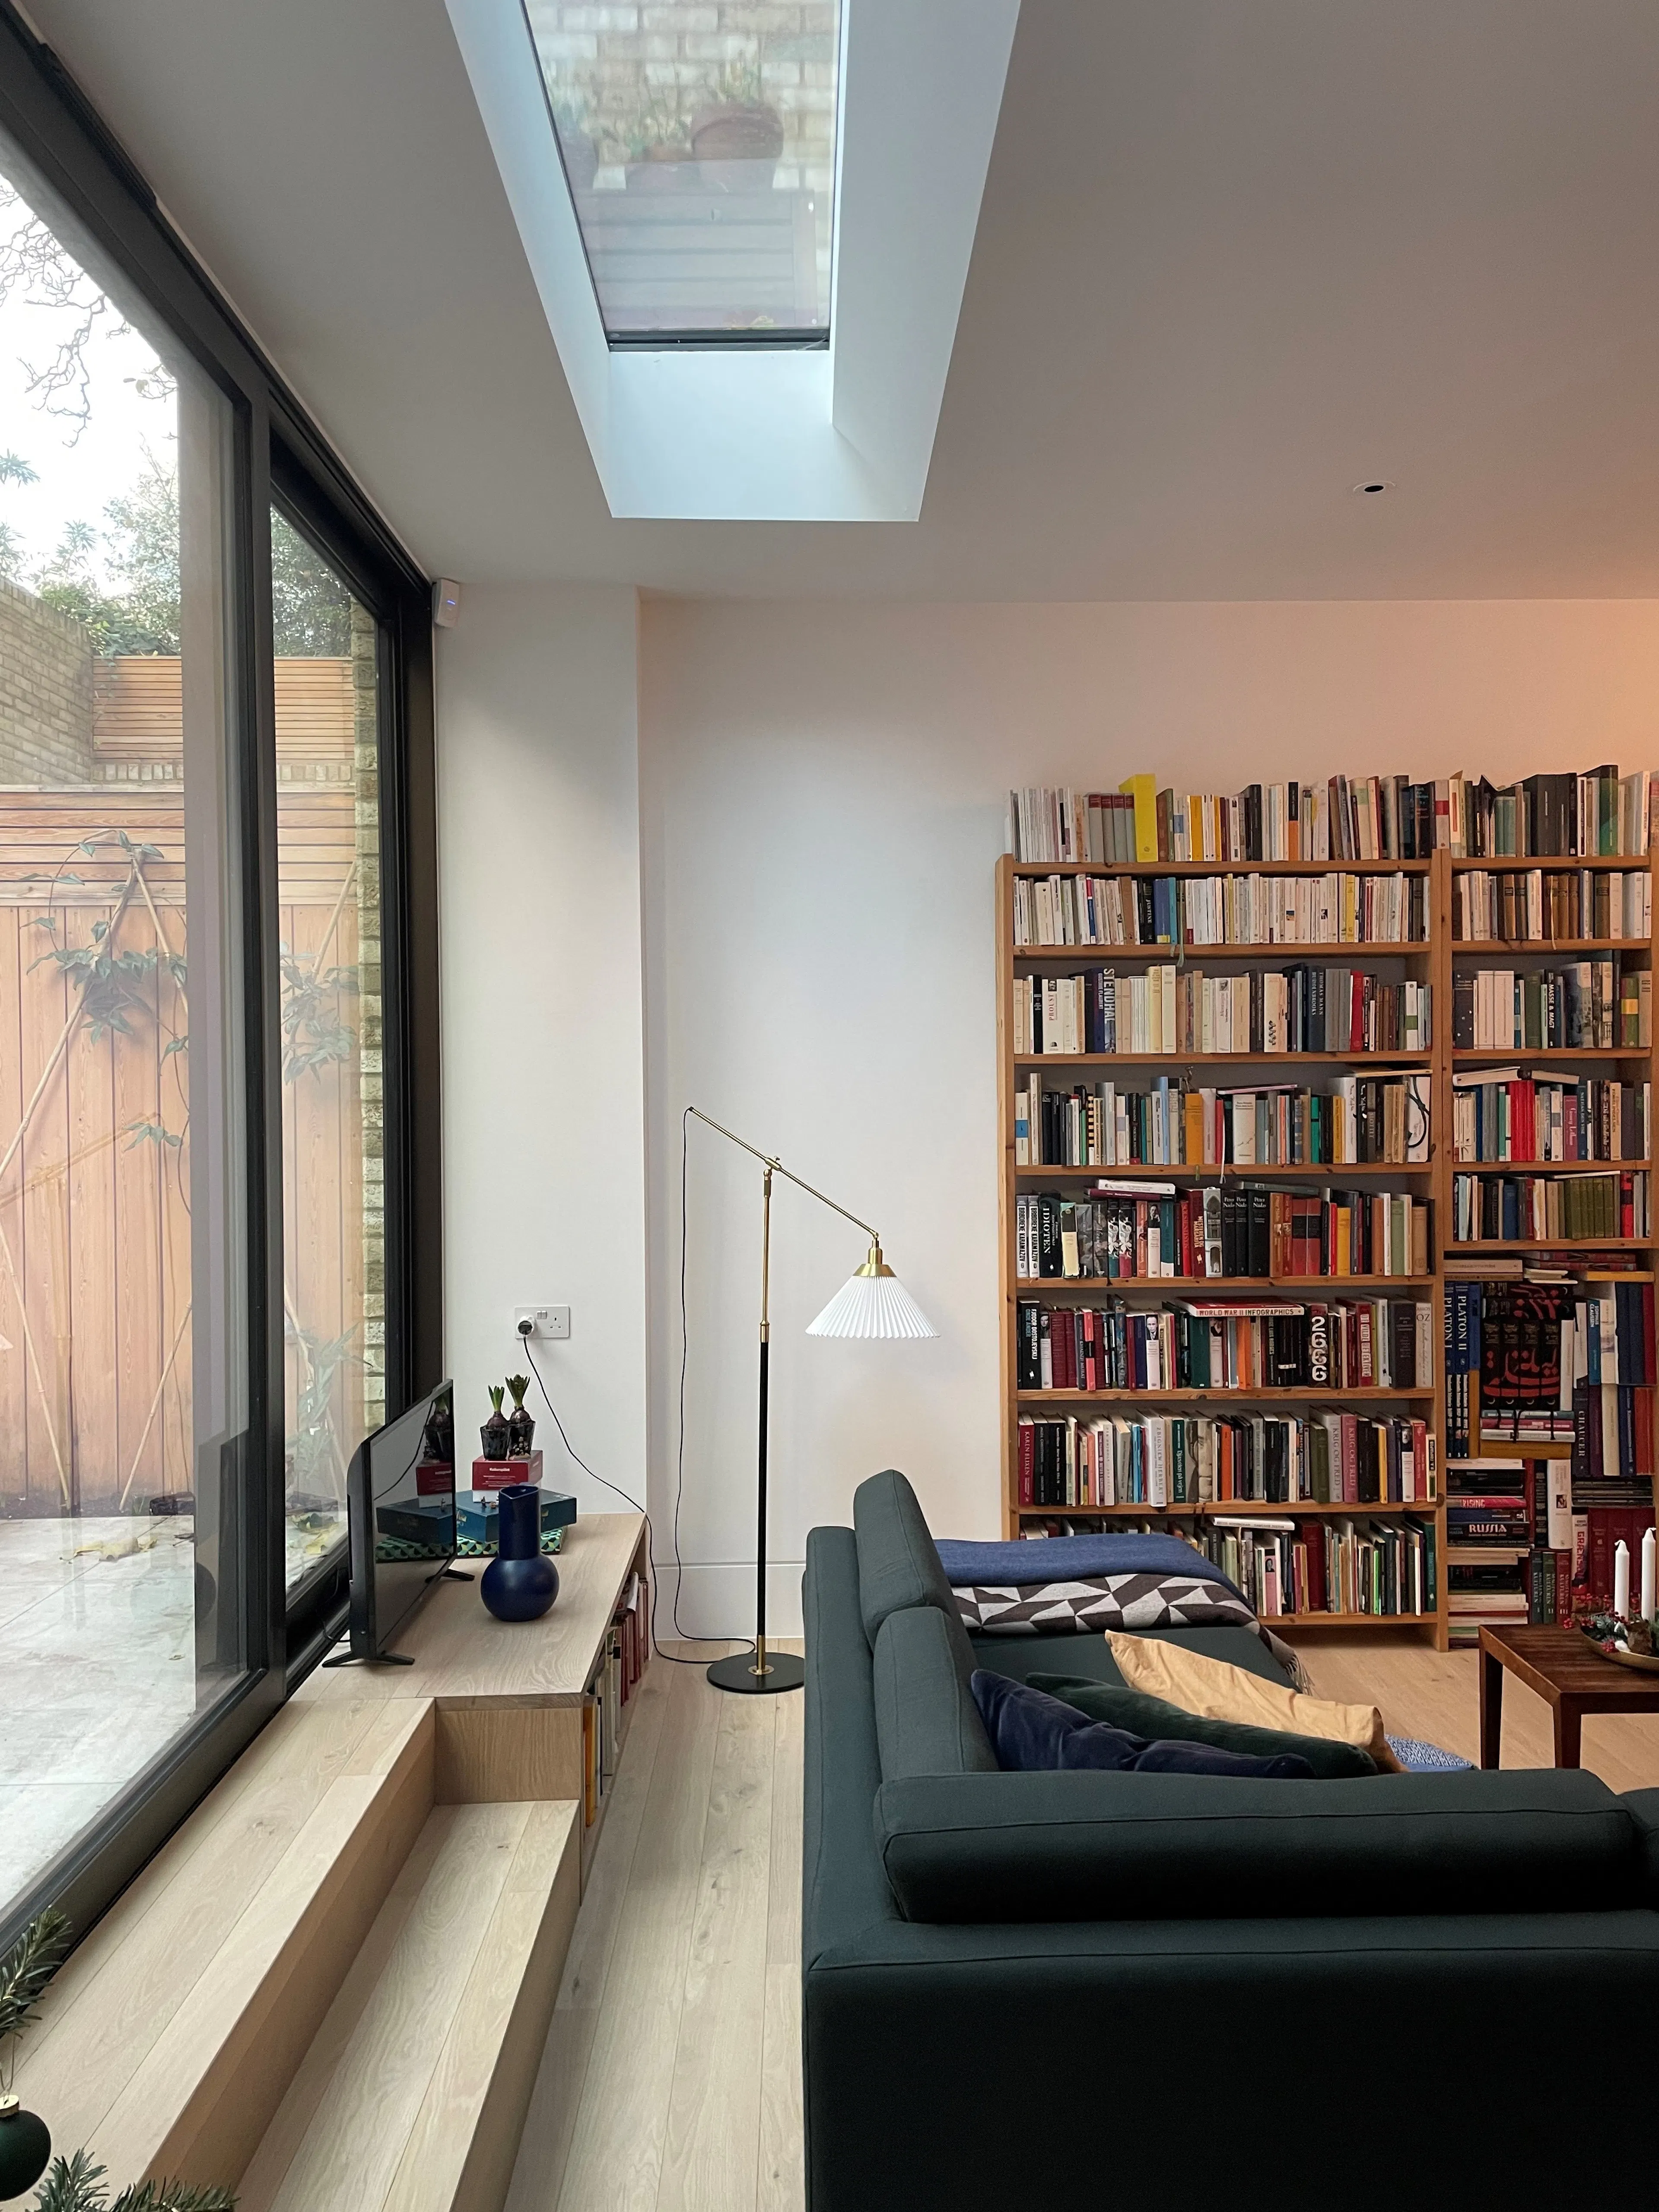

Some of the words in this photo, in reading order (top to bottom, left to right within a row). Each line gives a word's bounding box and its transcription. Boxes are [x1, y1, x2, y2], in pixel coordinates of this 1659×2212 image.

[1103, 969, 1115, 1023] STENDHAL
[1360, 1314, 1369, 1322] DE
[1458, 1296, 1466, 1339] PLATON
[1361, 1324, 1370, 1341] VILDE
[1312, 1316, 1327, 1381] 2666
[1361, 1343, 1371, 1377] DETEKTIVER
[1334, 1450, 1339, 1462] OG
[1349, 1450, 1355, 1462] OG
[1469, 1524, 1507, 1533] RUSSIA
